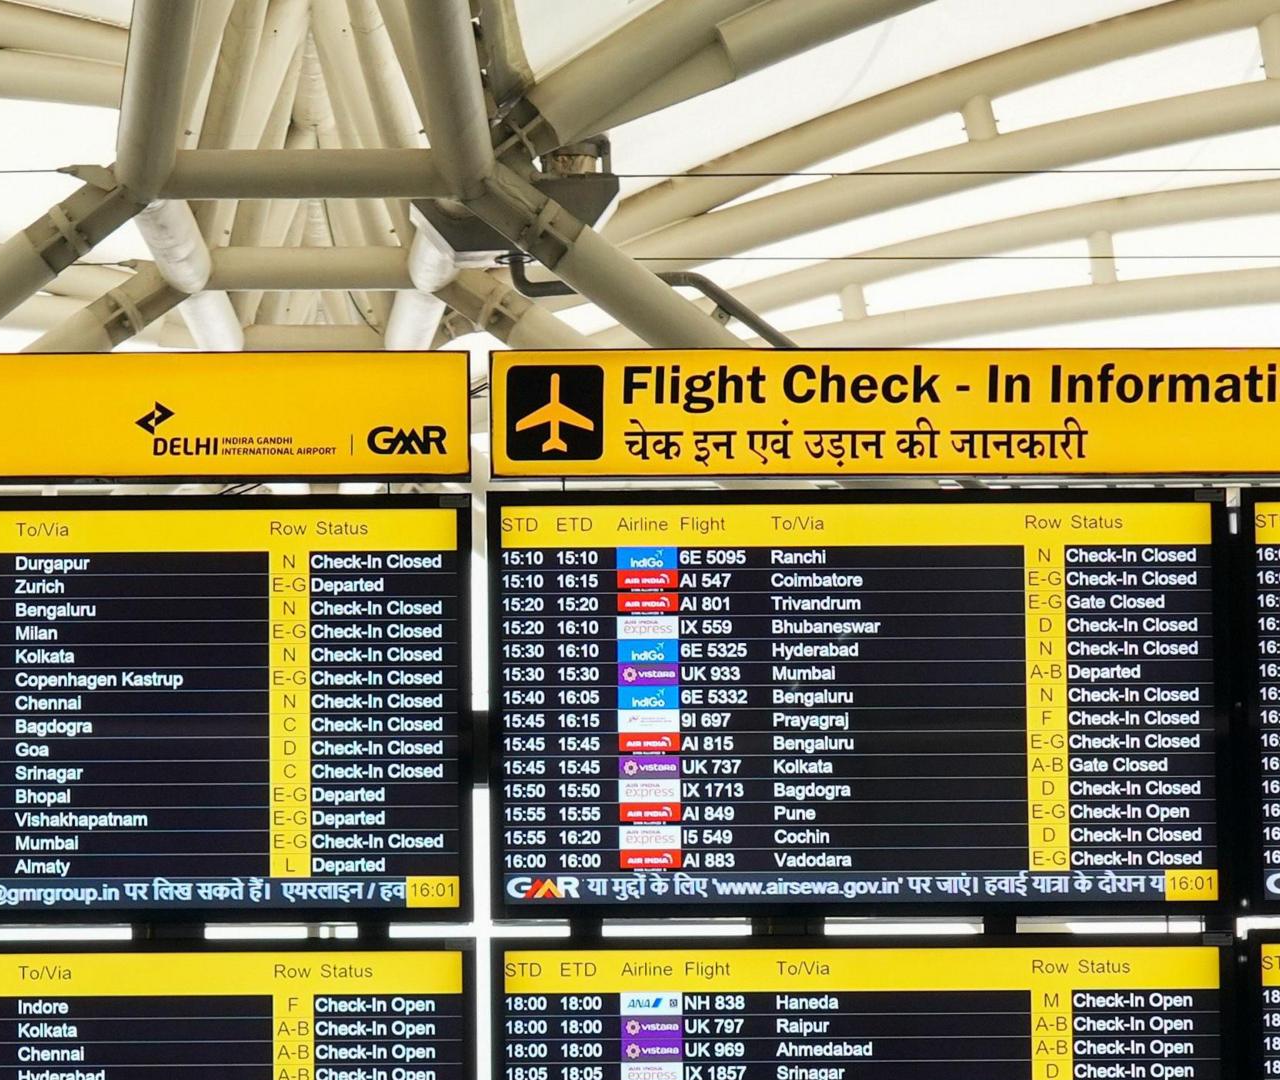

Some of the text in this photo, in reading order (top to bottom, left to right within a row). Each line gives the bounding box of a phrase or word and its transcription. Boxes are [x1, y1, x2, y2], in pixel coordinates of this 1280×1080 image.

[624, 365, 765, 413] Flight
[783, 365, 940, 404] Check
[989, 365, 1031, 402] In
[153, 438, 218, 455] DELHI
[368, 424, 447, 454] GMR
[624, 417, 1088, 467] चेक इन एवं उड़ान की जानकारी
[296, 447, 336, 455] AIRPORT
[503, 616, 1197, 634] 15:20 16:10 IX 559 Bhubaneswar D Check-In Closed
[15, 672, 116, 690] Copenhagen
[122, 672, 183, 689] Kastrup
[272, 671, 306, 686] E-G
[312, 671, 382, 685] Check-In
[387, 671, 442, 684] Closed
[412, 883, 453, 897] 16:01
[983, 867, 1070, 898] हवाई यात्रा
[1171, 876, 1212, 890] 16:01
[19, 1000, 68, 1014] Indore
[289, 998, 298, 1011] F
[315, 997, 386, 1012] Check-In
[392, 997, 435, 1015] Open
[506, 993, 1192, 1010] 18:00 18:00 ANA NH 838 Haneda M Check-In Open
